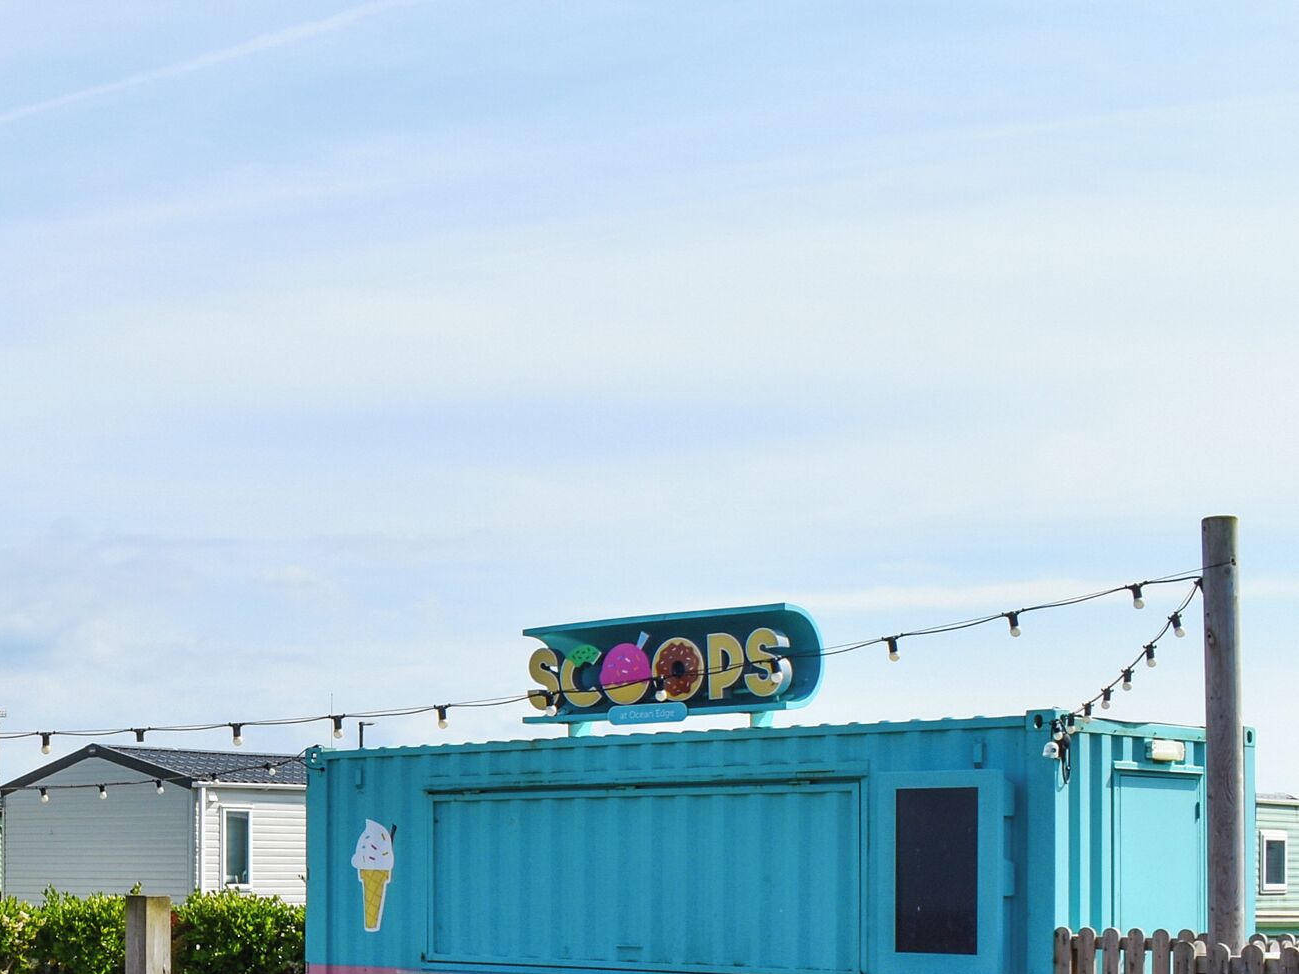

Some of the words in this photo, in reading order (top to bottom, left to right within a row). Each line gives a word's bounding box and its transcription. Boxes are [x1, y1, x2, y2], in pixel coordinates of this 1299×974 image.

[527, 628, 792, 710] SCOOPS
[629, 710, 654, 719] Ocean
[655, 709, 675, 719] Edge
